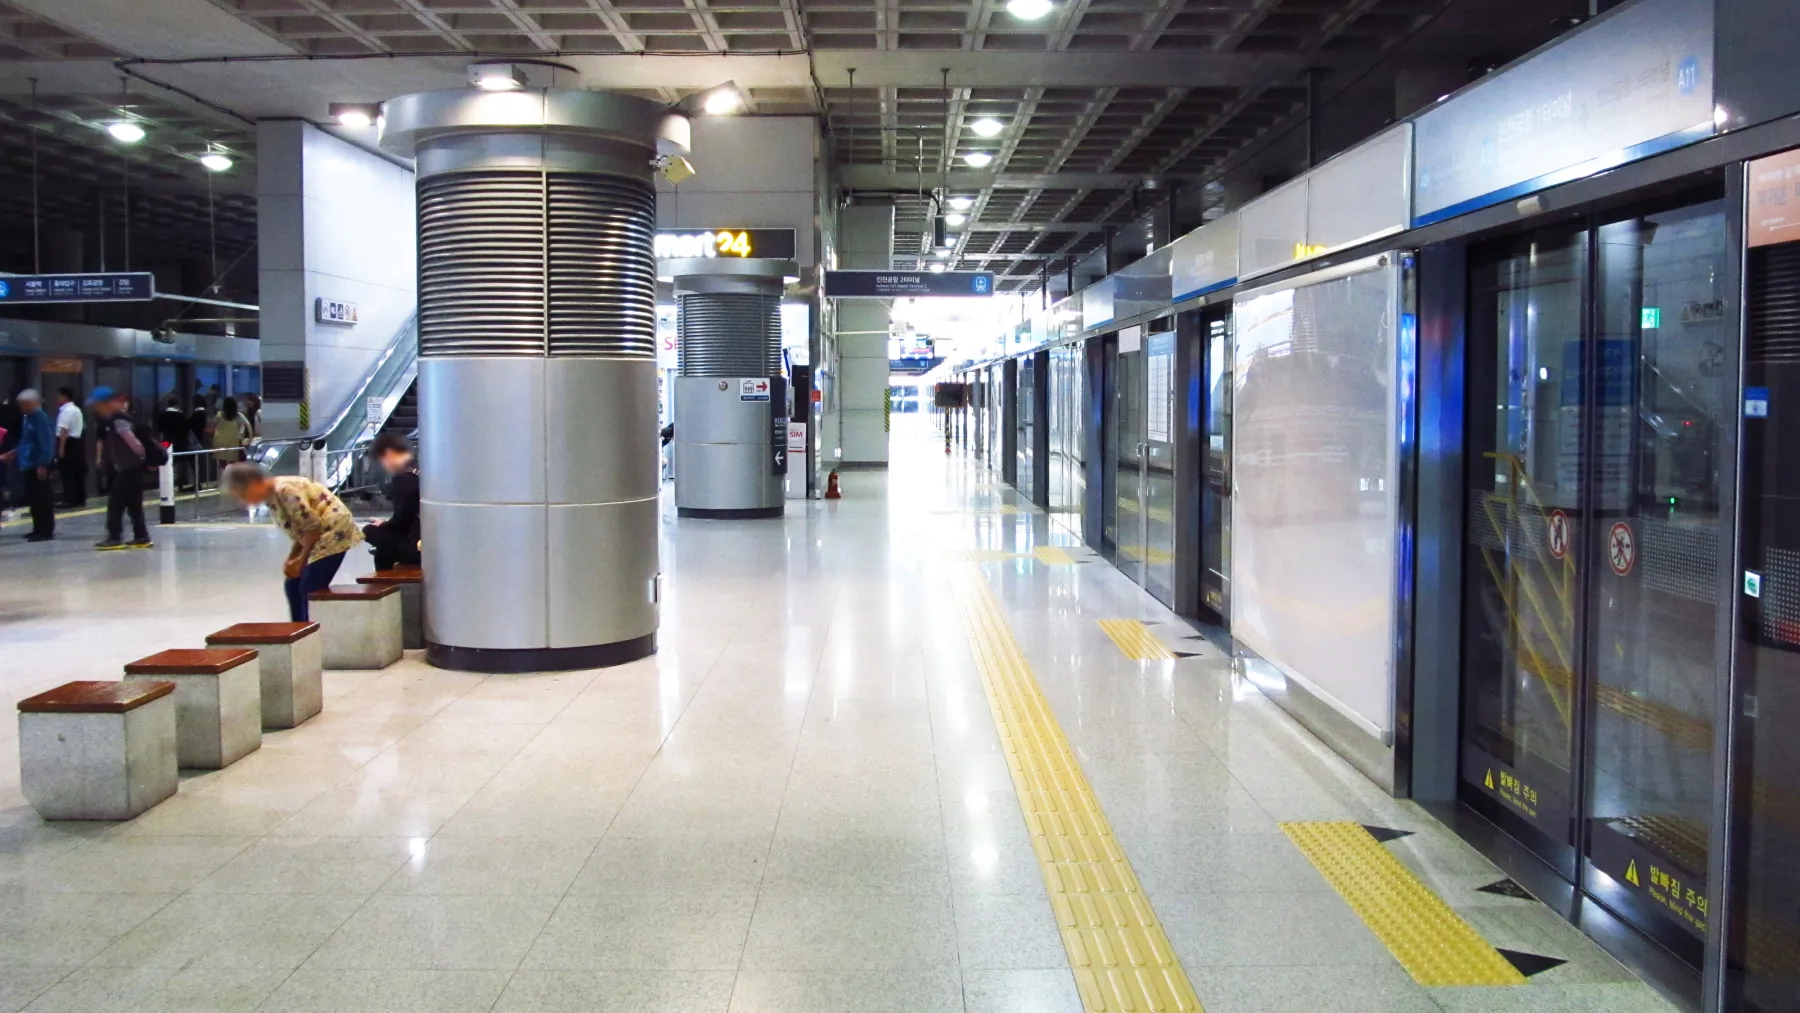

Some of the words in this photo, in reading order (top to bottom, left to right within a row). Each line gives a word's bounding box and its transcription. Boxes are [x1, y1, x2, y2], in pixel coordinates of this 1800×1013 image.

[1677, 65, 1696, 91] A11
[1500, 770, 1520, 796] 발빠짐
[1523, 784, 1537, 807] 주의
[1649, 864, 1681, 900] 발빠짐
[1685, 887, 1707, 918] 주의
